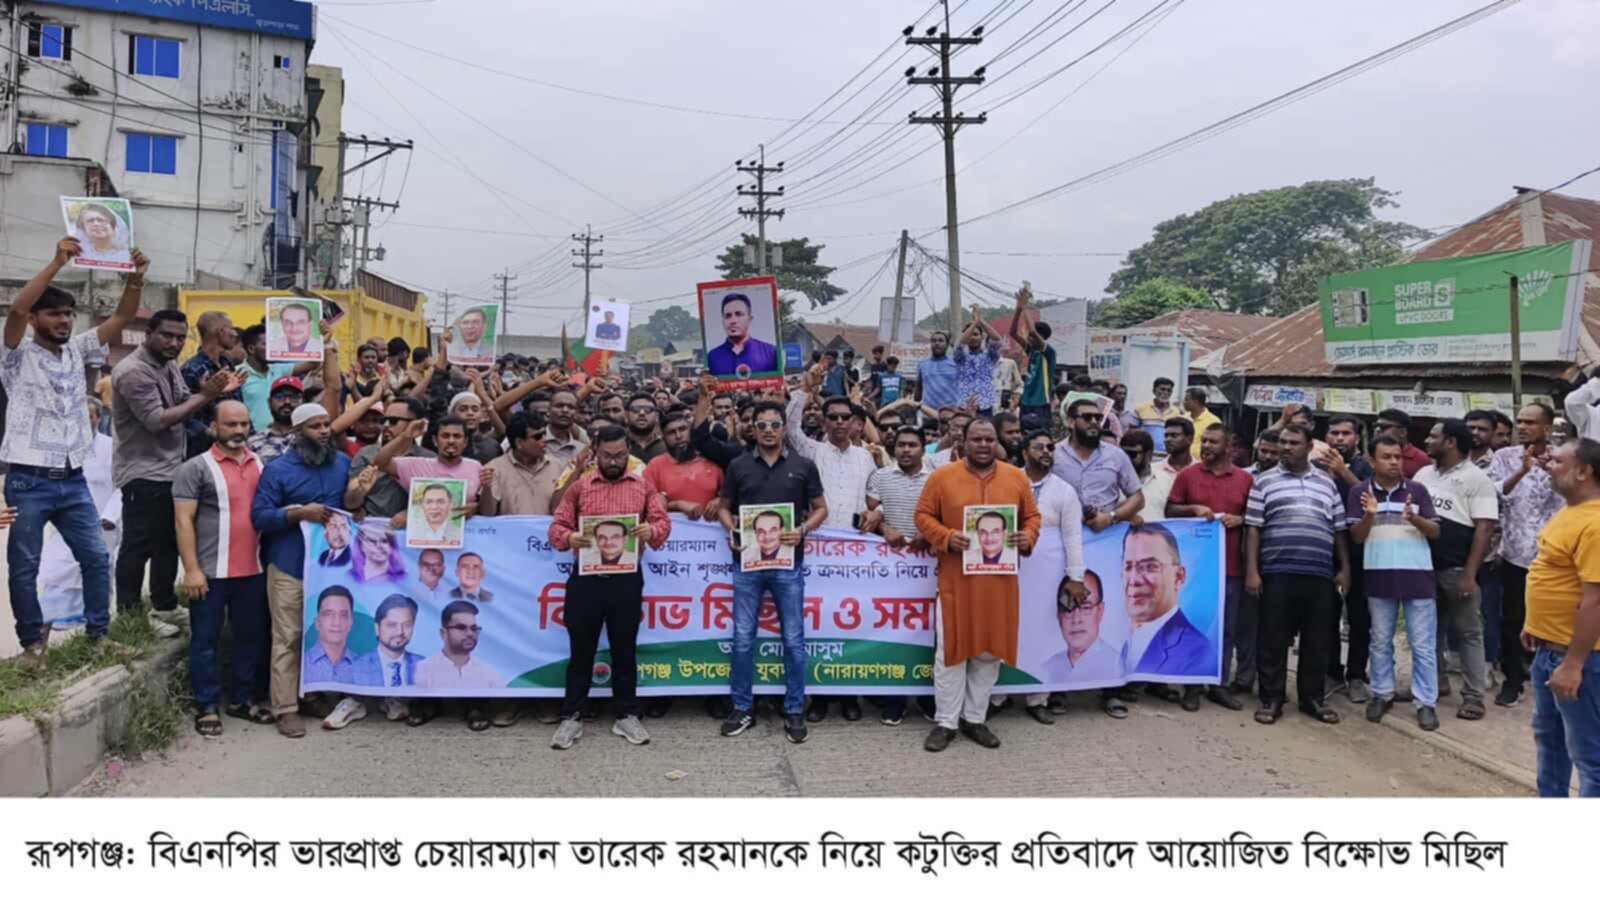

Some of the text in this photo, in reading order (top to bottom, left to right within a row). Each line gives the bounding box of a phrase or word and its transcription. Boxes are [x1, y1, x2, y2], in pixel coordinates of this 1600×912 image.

[1394, 281, 1432, 297] SUPER
[1394, 296, 1432, 310] BOARD
[648, 558, 692, 578] আইন
[816, 560, 890, 579] ক্রমাবনতি
[895, 561, 928, 579] নিয়ে
[833, 597, 862, 631] ও
